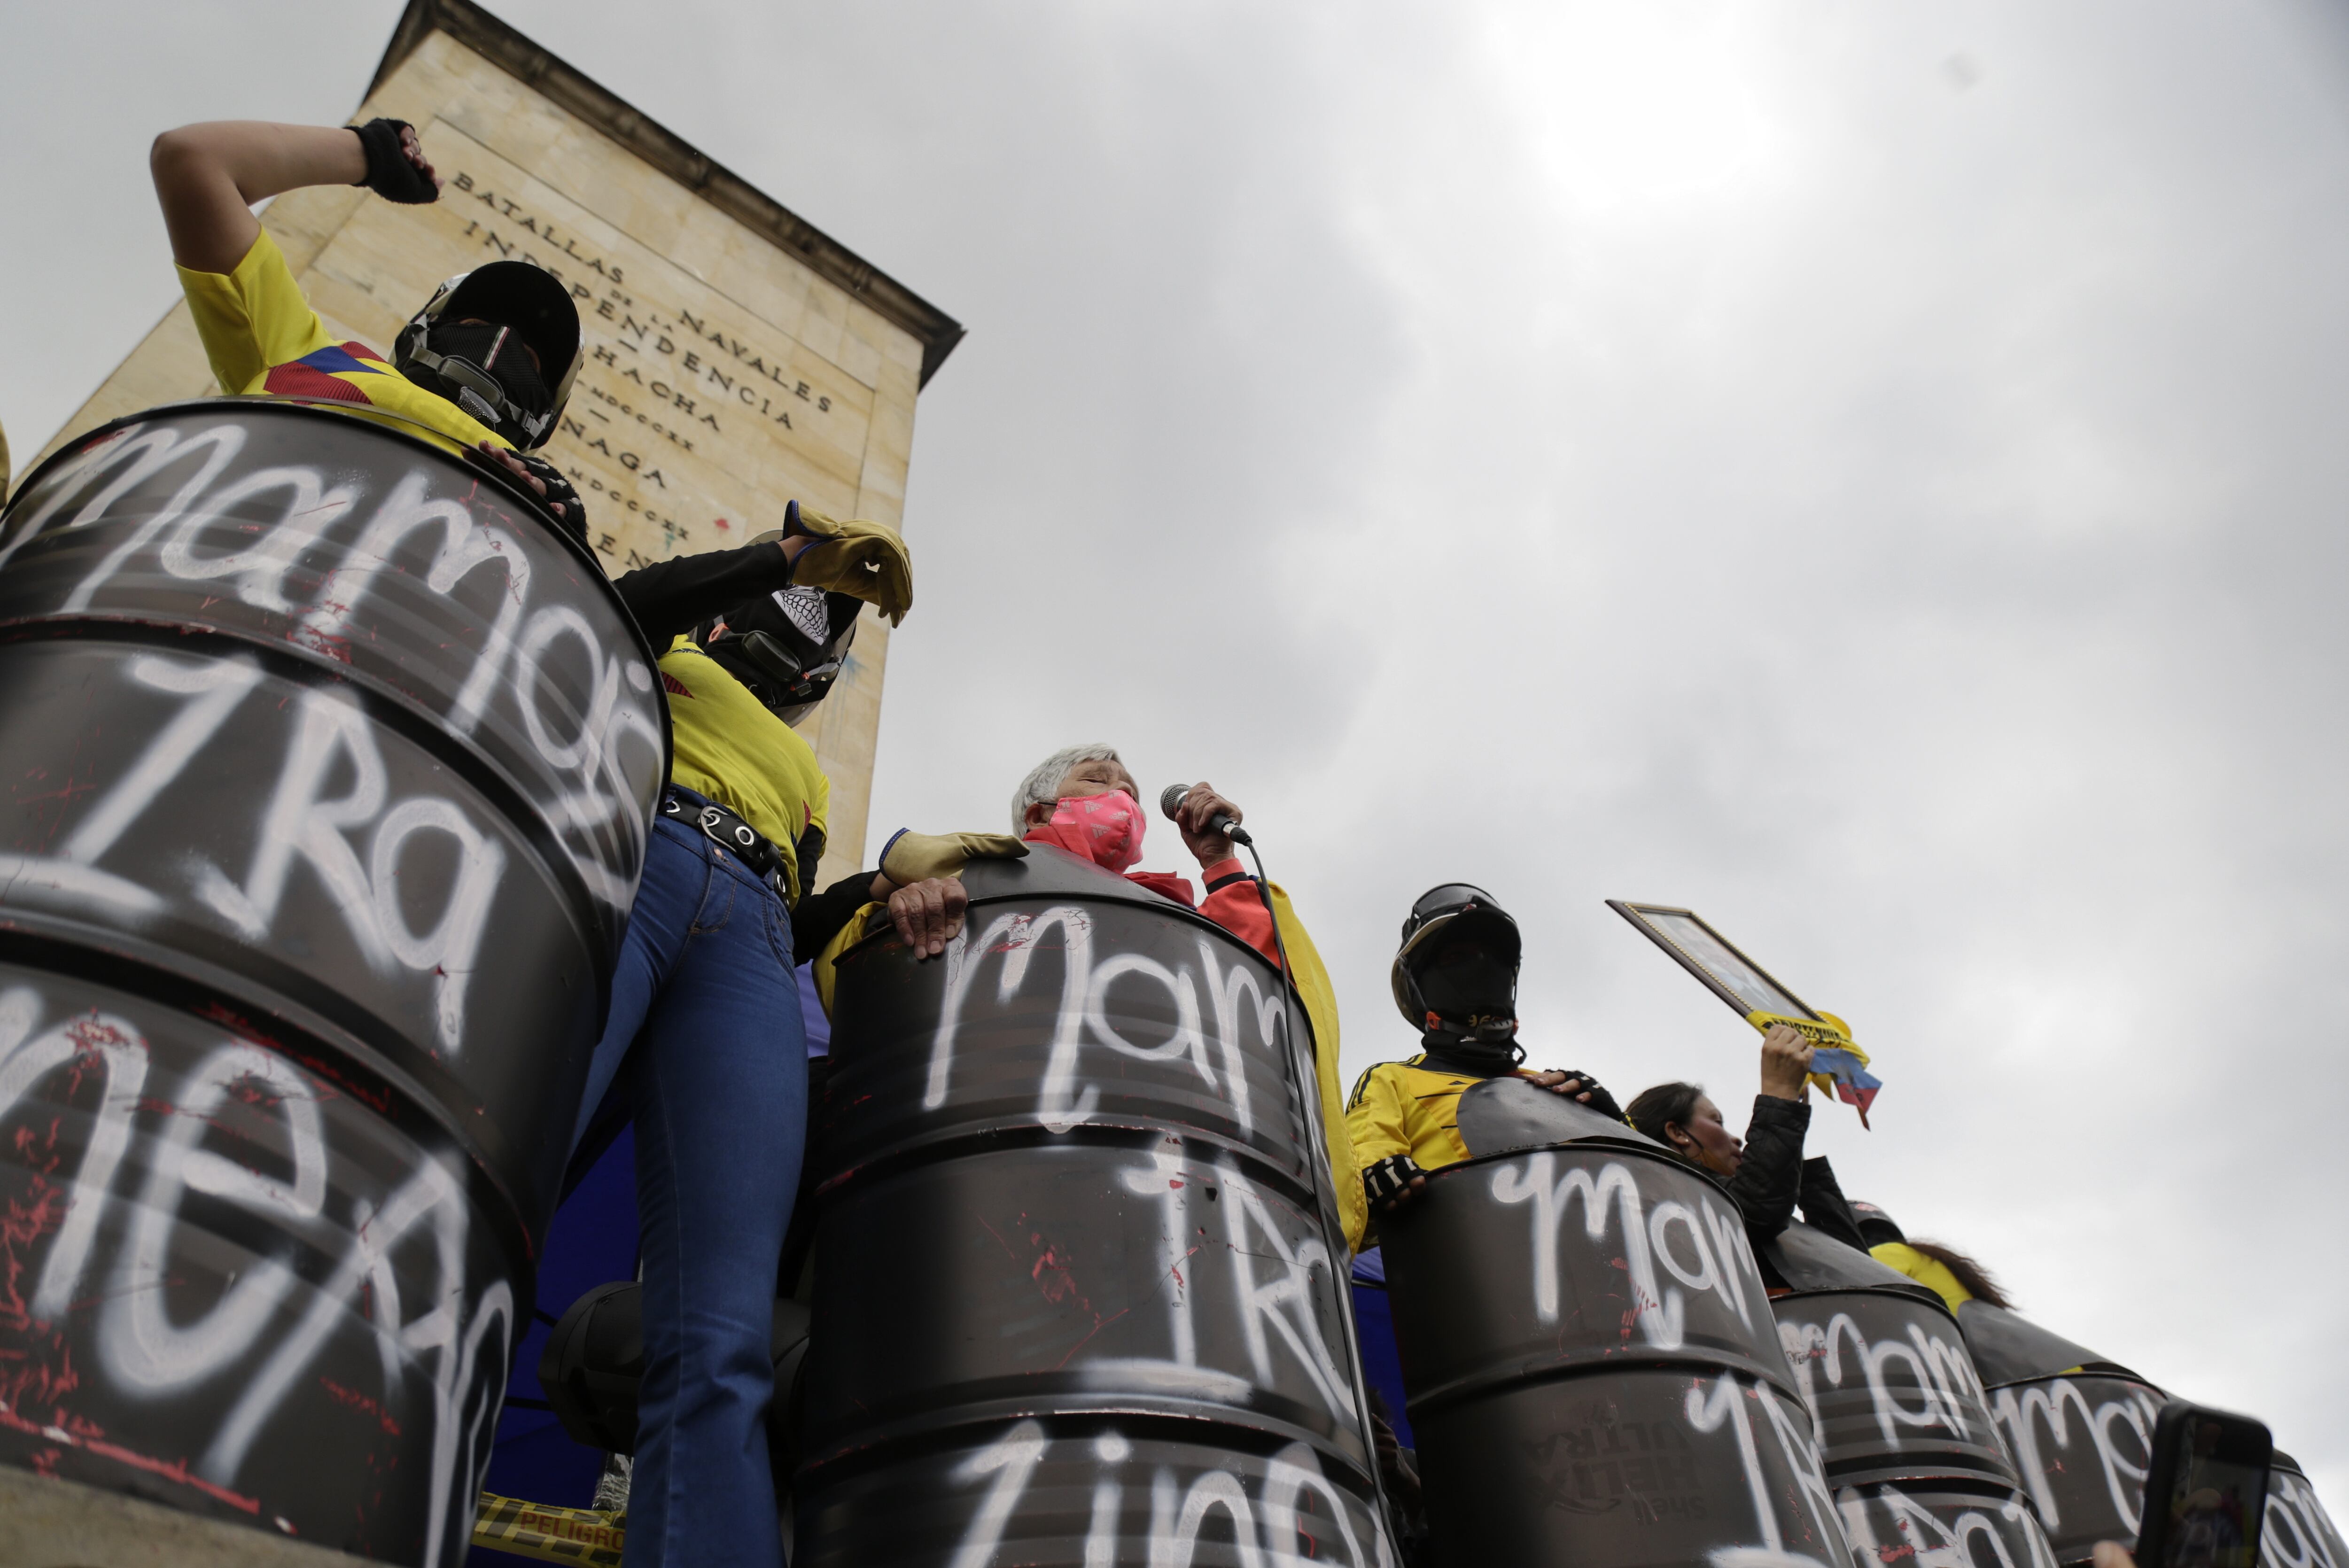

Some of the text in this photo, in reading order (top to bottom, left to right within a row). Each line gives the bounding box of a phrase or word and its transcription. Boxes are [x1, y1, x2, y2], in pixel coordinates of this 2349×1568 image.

[452, 171, 832, 413] BATALLAS NAVALES
[520, 1511, 625, 1551] PELIGRO
